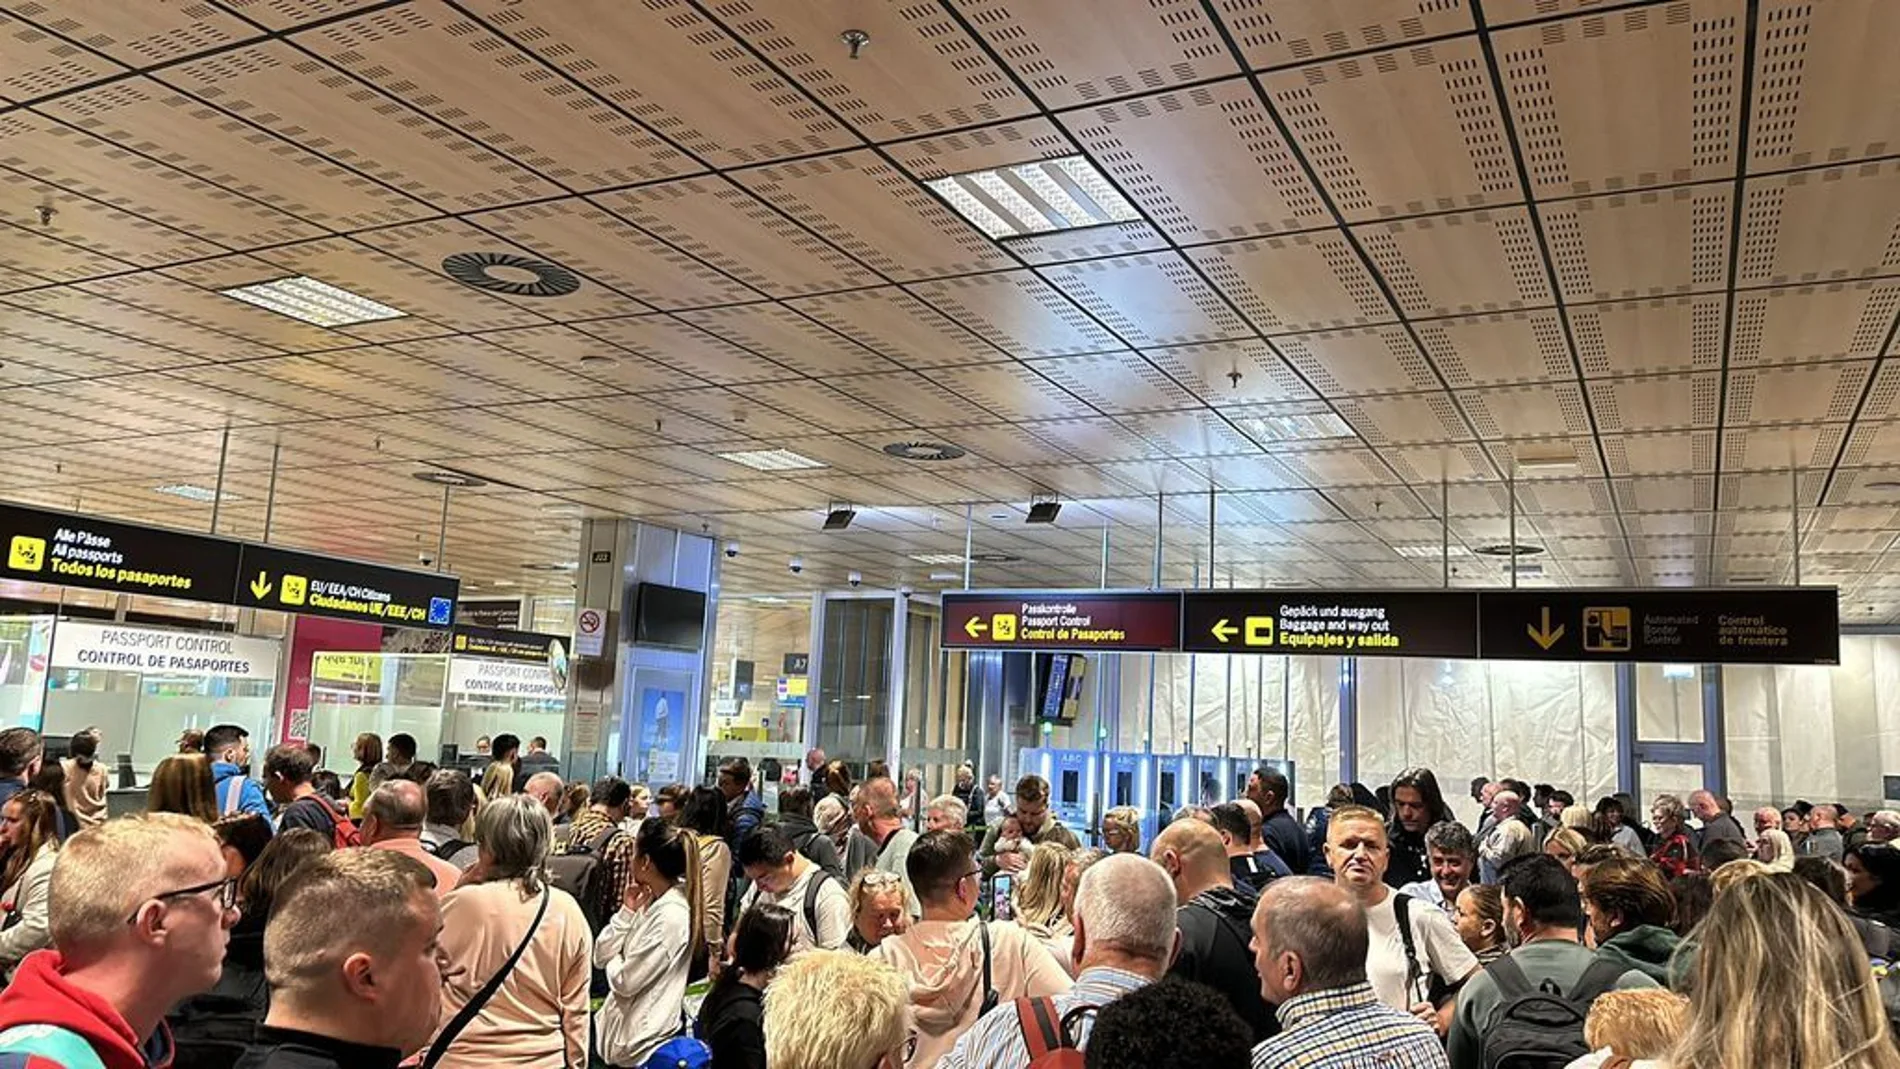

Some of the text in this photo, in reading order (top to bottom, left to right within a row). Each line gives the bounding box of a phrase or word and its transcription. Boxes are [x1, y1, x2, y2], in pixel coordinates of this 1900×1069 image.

[54, 528, 112, 548] Alle Pässe
[52, 543, 123, 564] All passports
[50, 557, 192, 589] Todos los pasaportes
[309, 593, 368, 613] Ciudadanos
[1022, 603, 1077, 614] Passkontrolle
[1280, 604, 1386, 620] Gepäck und ausgang
[1643, 615, 1699, 625] Automated
[1718, 614, 1765, 625] Control
[1022, 615, 1091, 628] Passport Control
[1280, 618, 1390, 634] Baggage and way out
[1021, 627, 1126, 643] Control de Pasaportes
[1643, 625, 1678, 635] Border
[101, 630, 234, 654] PASSPORT CONTROL
[1280, 632, 1399, 649] Equipajes y salida
[1643, 635, 1682, 645] Control
[1719, 635, 1788, 646] de frontera
[77, 649, 250, 674] CONTROL DE PASAPORTES
[479, 664, 521, 678] PASSPORT
[465, 679, 504, 692] CONTROL
[506, 681, 518, 693] DE
